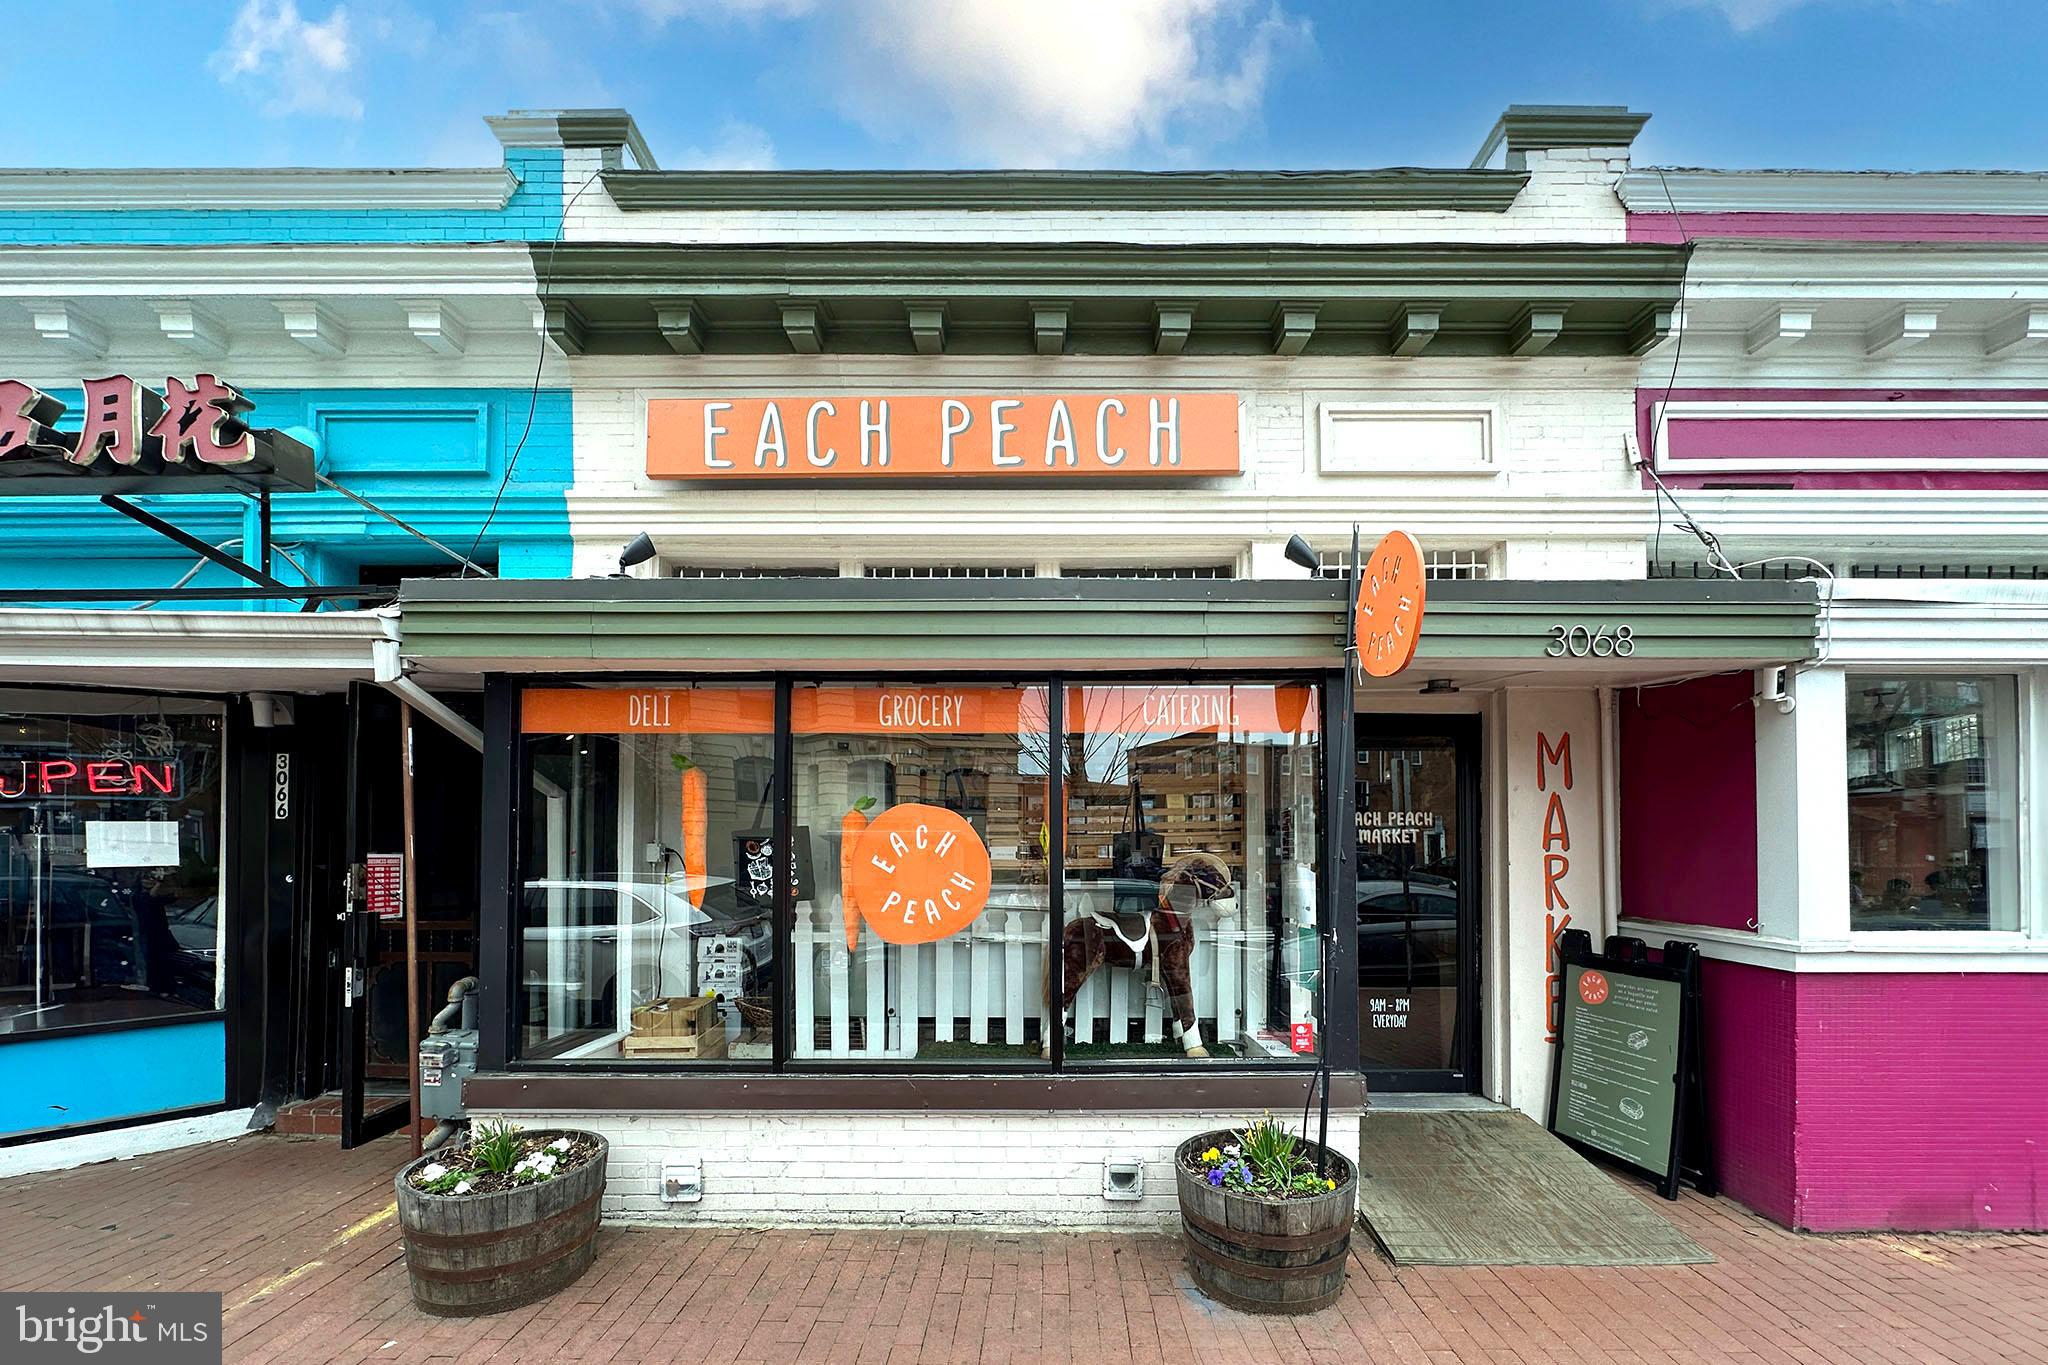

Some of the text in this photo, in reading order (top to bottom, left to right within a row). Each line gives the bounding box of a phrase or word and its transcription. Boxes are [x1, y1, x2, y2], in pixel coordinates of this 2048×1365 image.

[702, 397, 1182, 469] EACH PEACH
[1362, 555, 1402, 617] EACH
[1367, 595, 1412, 660] PEACH
[1546, 624, 1635, 657] 3068
[628, 694, 672, 727] DELI
[878, 694, 964, 727] GROCERY
[1143, 694, 1240, 727] CATERING
[276, 754, 288, 818] 3066
[1355, 811, 1433, 826] ACH PEACH
[871, 824, 957, 875] EACH
[1358, 828, 1420, 844] MARKET
[881, 871, 976, 924] PEACH
[1536, 731, 1573, 1043] MARKE
[1582, 975, 1602, 987] EACH
[1584, 988, 1605, 1000] PEACH
[1369, 998, 1387, 1012] 9AM
[1395, 998, 1410, 1012] 8PM
[1372, 1014, 1408, 1028] EVERYDAY
